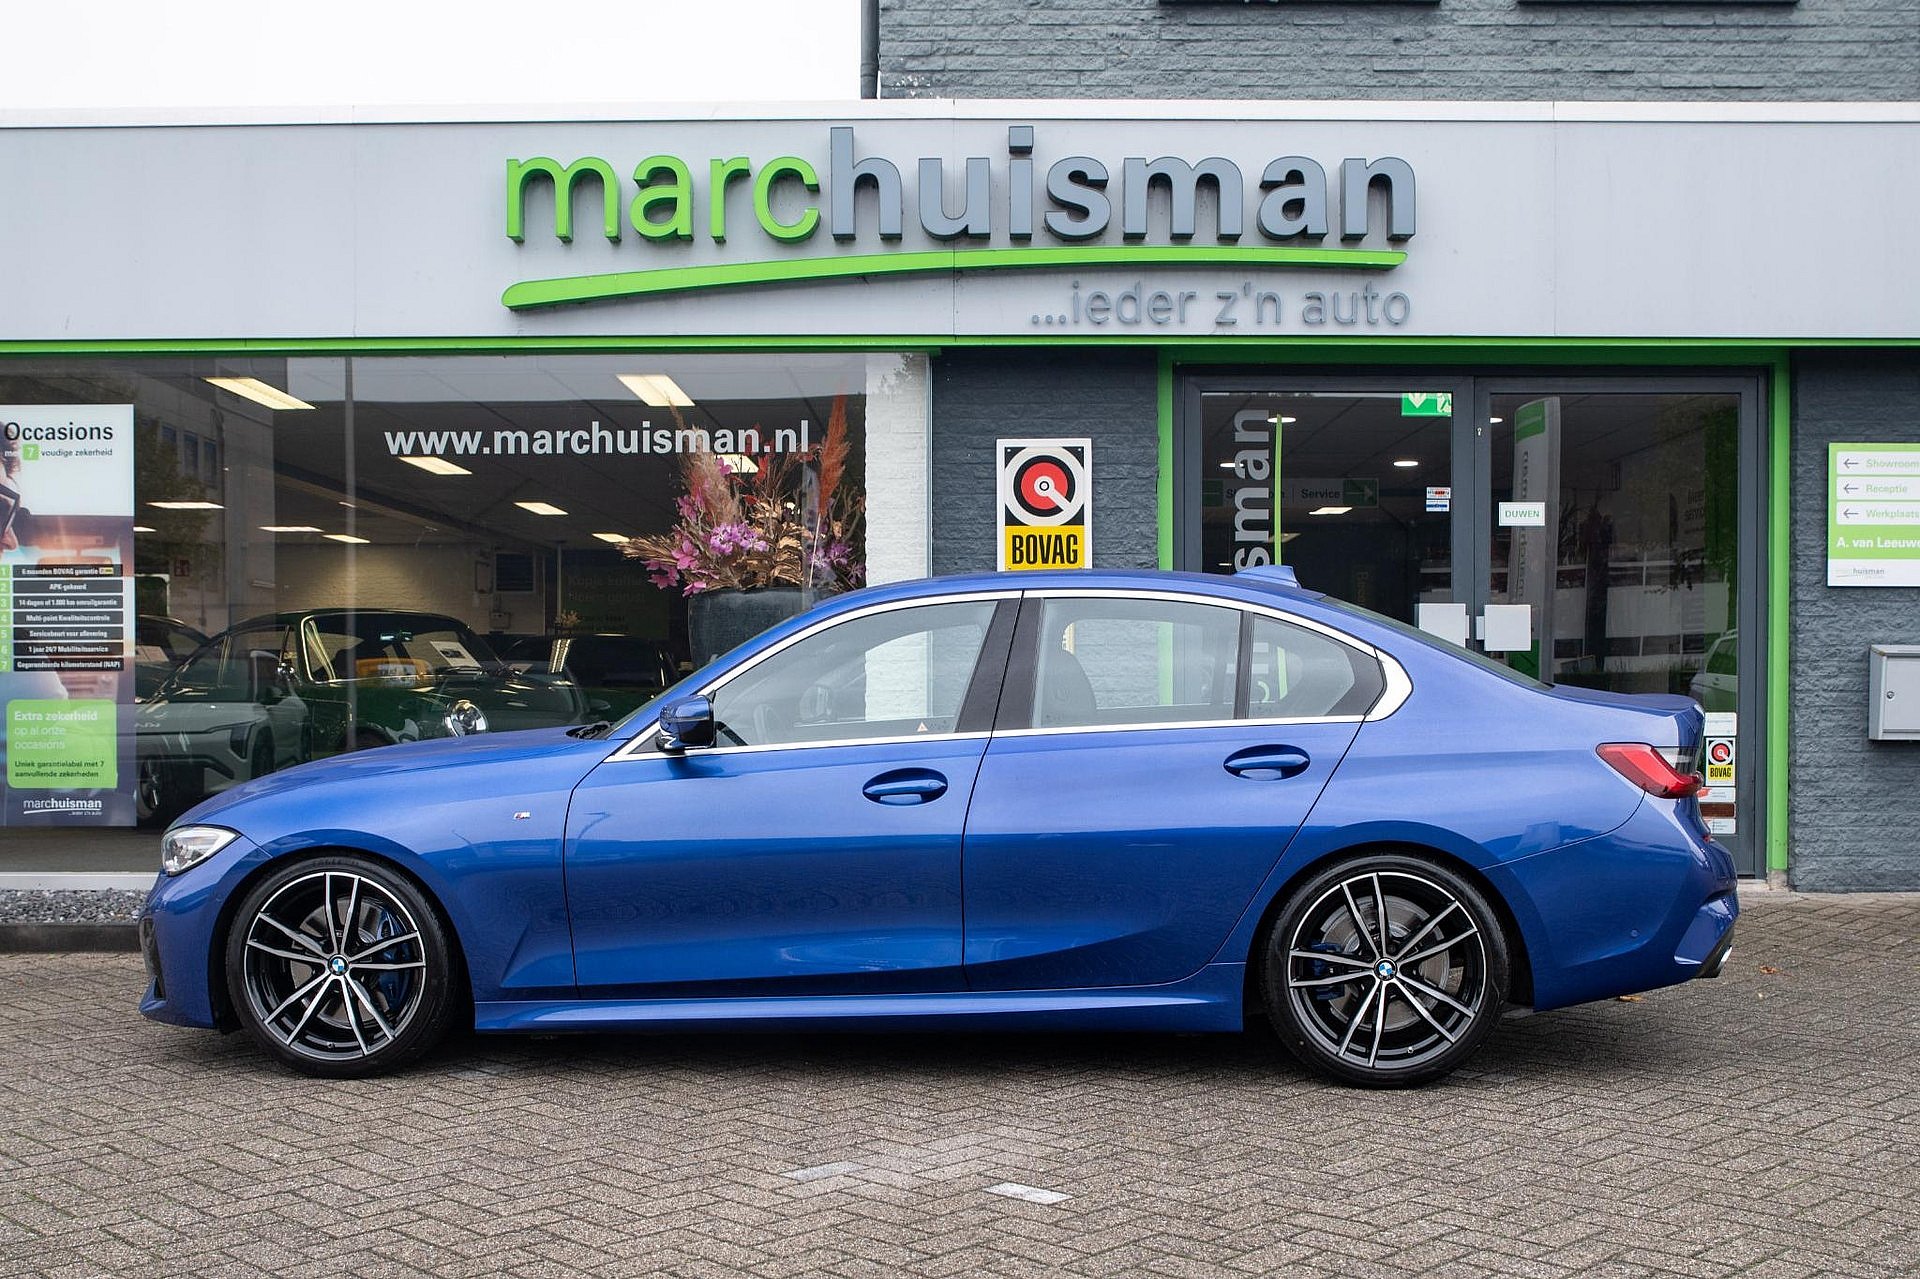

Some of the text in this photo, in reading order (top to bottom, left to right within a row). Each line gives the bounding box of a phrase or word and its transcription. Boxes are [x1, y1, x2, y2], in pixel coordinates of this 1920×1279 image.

[506, 125, 1416, 243] marchuisman
[1031, 281, 1410, 326] ...ieder z'n auto
[4, 421, 113, 441] Occasions
[384, 419, 809, 455] www.marchuisman.nl
[41, 449, 73, 458] voudige
[75, 449, 113, 457] zekerheid
[1866, 458, 1920, 468] Showroom
[1301, 488, 1341, 499] Service
[1866, 484, 1908, 494] Receptie
[1504, 510, 1540, 518] DUWEN
[1866, 509, 1920, 519] Werkplaats
[1836, 537, 1849, 548] A.
[1852, 539, 1874, 548] van
[1011, 534, 1078, 565] BOVAG
[53, 567, 74, 575] BOVAG
[14, 711, 98, 721] Extra zekerheid
[14, 727, 28, 736] op
[14, 740, 65, 749] occasions
[14, 760, 35, 768] Uniek
[37, 760, 82, 769] garantielabel
[84, 760, 98, 768] met
[14, 770, 99, 778] aanvullende zekerheden
[1710, 767, 1732, 778] BOVAG
[23, 797, 102, 809] marchuisman
